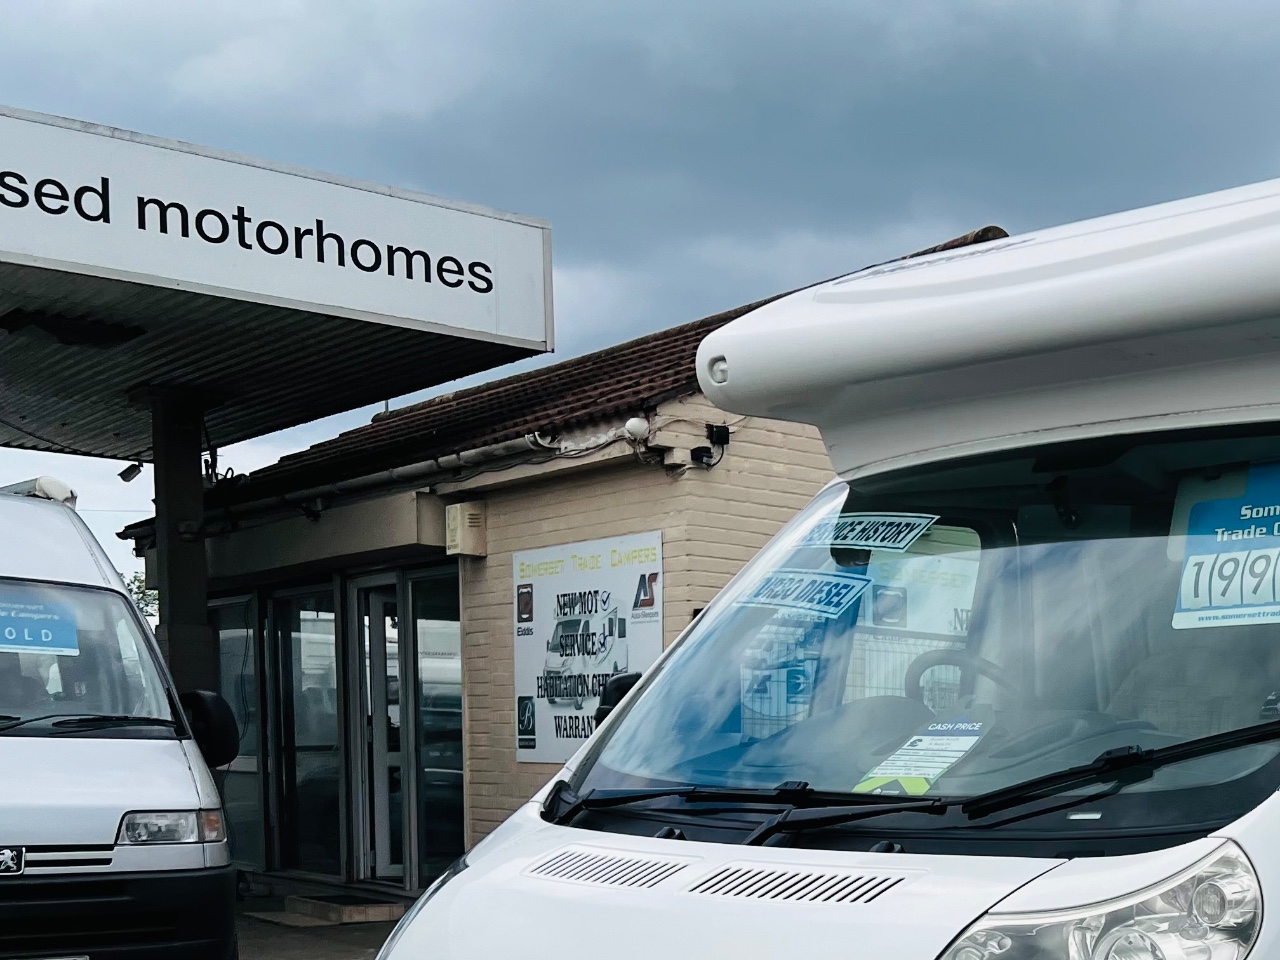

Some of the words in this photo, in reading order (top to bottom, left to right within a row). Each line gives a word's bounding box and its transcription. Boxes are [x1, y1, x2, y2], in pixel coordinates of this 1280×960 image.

[0, 170, 111, 224] sed
[136, 195, 495, 294] motorhomes
[856, 521, 922, 544] HISTORY
[1214, 524, 1267, 543] Trade
[519, 559, 565, 579] SOMERSET
[610, 546, 657, 568] CAMPERS
[556, 593, 577, 618] NEW
[578, 590, 599, 614] MOT
[793, 579, 856, 608] DIESEL
[4, 627, 53, 642] OLD
[559, 633, 597, 657] SERVICE
[536, 674, 589, 699] HABITATION
[591, 673, 619, 698] CHE
[554, 715, 596, 739] WARRAN
[928, 723, 955, 731] CASH
[955, 722, 983, 731] PRICE
